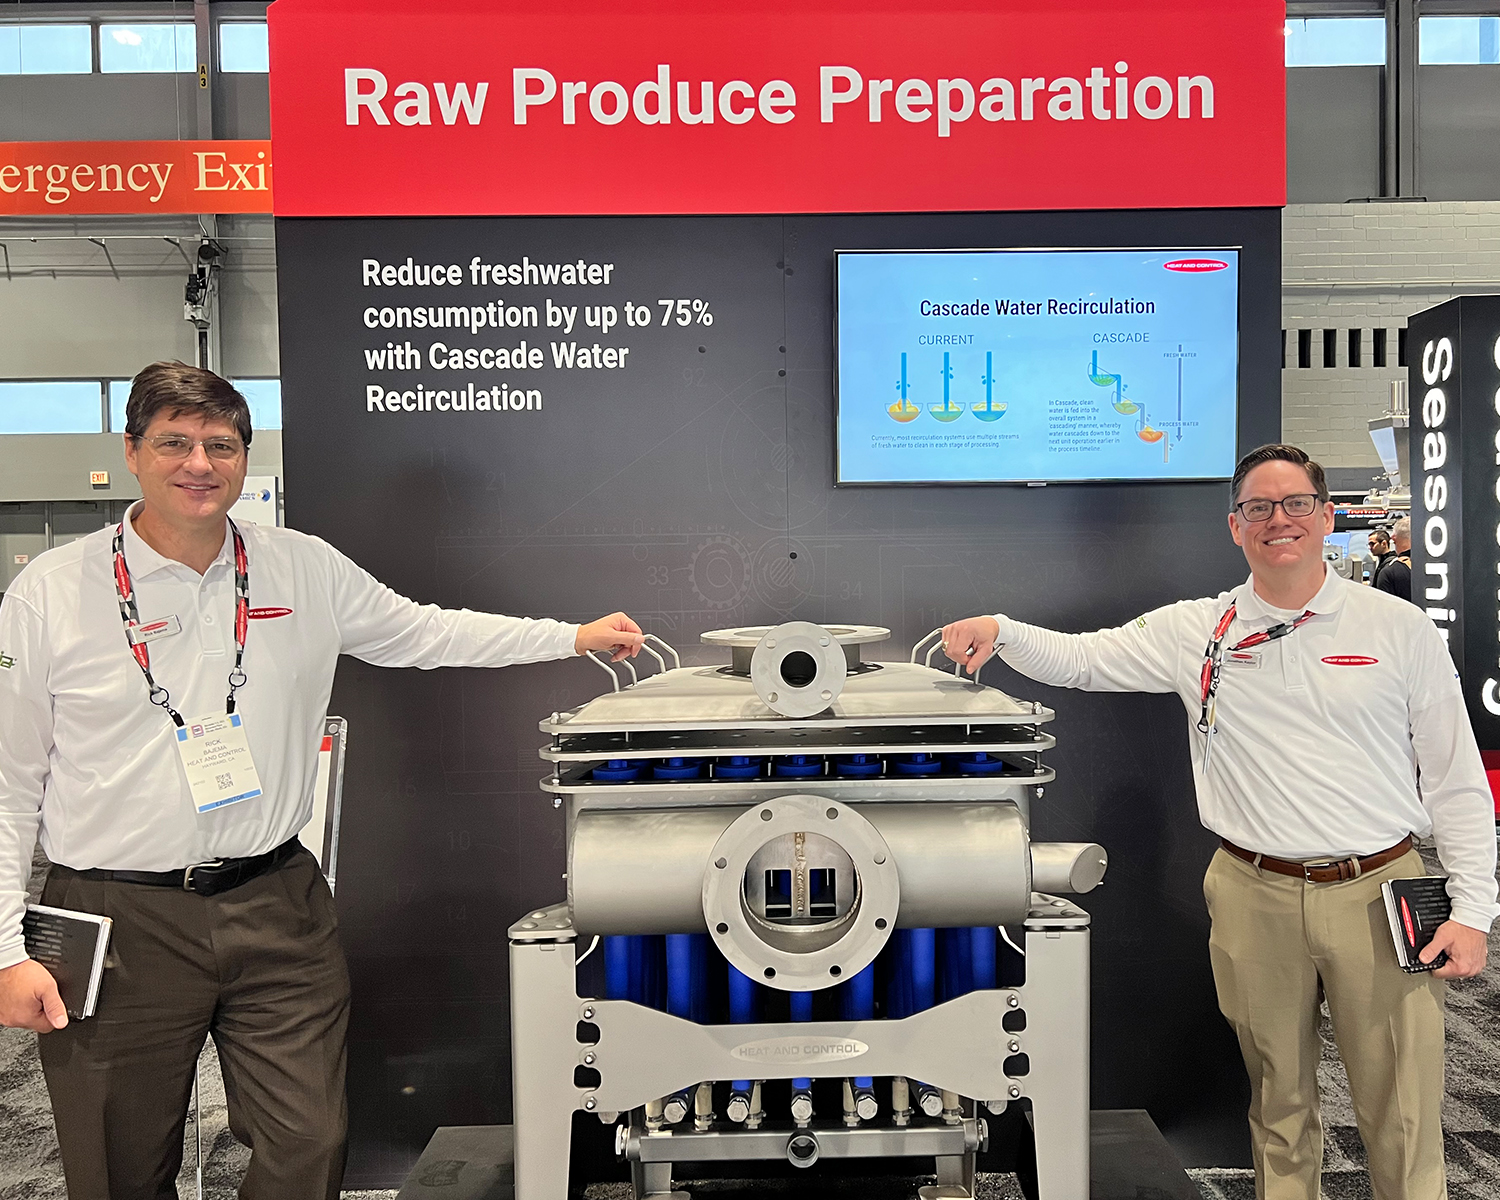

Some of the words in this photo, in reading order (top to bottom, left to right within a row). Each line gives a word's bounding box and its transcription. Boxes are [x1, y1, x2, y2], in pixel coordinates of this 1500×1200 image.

[344, 68, 489, 127] Raw
[512, 64, 798, 126] Produce
[819, 61, 1215, 137] Preparation
[193, 151, 272, 191] Exi
[361, 259, 463, 288] Reduce
[469, 258, 615, 287] freshwater
[362, 302, 539, 334] consumption
[545, 301, 579, 332] by
[584, 304, 619, 334] up
[624, 303, 652, 329] to
[658, 299, 714, 329] 75%
[919, 299, 991, 318] Cascade
[994, 298, 1043, 317] Water
[1047, 297, 1156, 316] Recirculation
[918, 333, 975, 346] CURRENT
[1092, 332, 1150, 344] CASCADE
[364, 343, 422, 372] with
[428, 341, 544, 371] Cascade
[551, 342, 629, 370] Water
[365, 383, 544, 413] Recirculation
[92, 473, 105, 482] EXIT
[203, 745, 228, 756] BAJEMA
[205, 738, 222, 747] RICK
[187, 758, 203, 767] HEAT
[204, 754, 217, 762] AND
[217, 747, 246, 759] CONTROL
[739, 1046, 772, 1056] HEAT
[774, 1046, 800, 1055] AND
[803, 1044, 860, 1054] CONTROL
